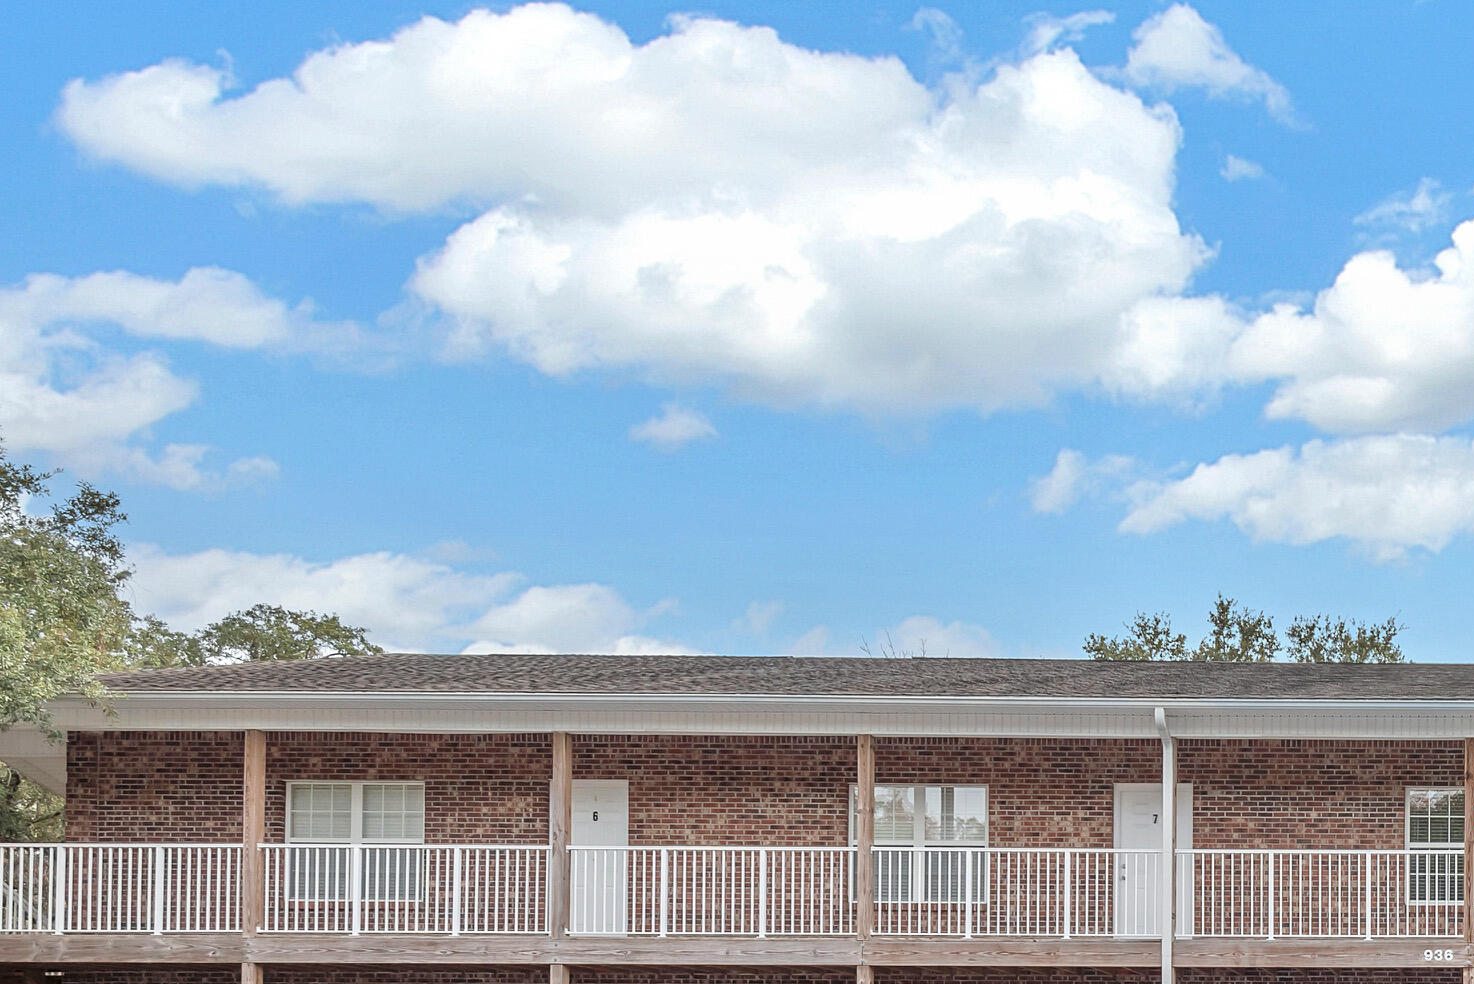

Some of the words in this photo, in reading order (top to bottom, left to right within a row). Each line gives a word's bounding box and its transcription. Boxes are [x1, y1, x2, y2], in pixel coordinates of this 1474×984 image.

[593, 811, 599, 822] 6
[1153, 814, 1158, 824] 7
[1423, 949, 1454, 961] 936
